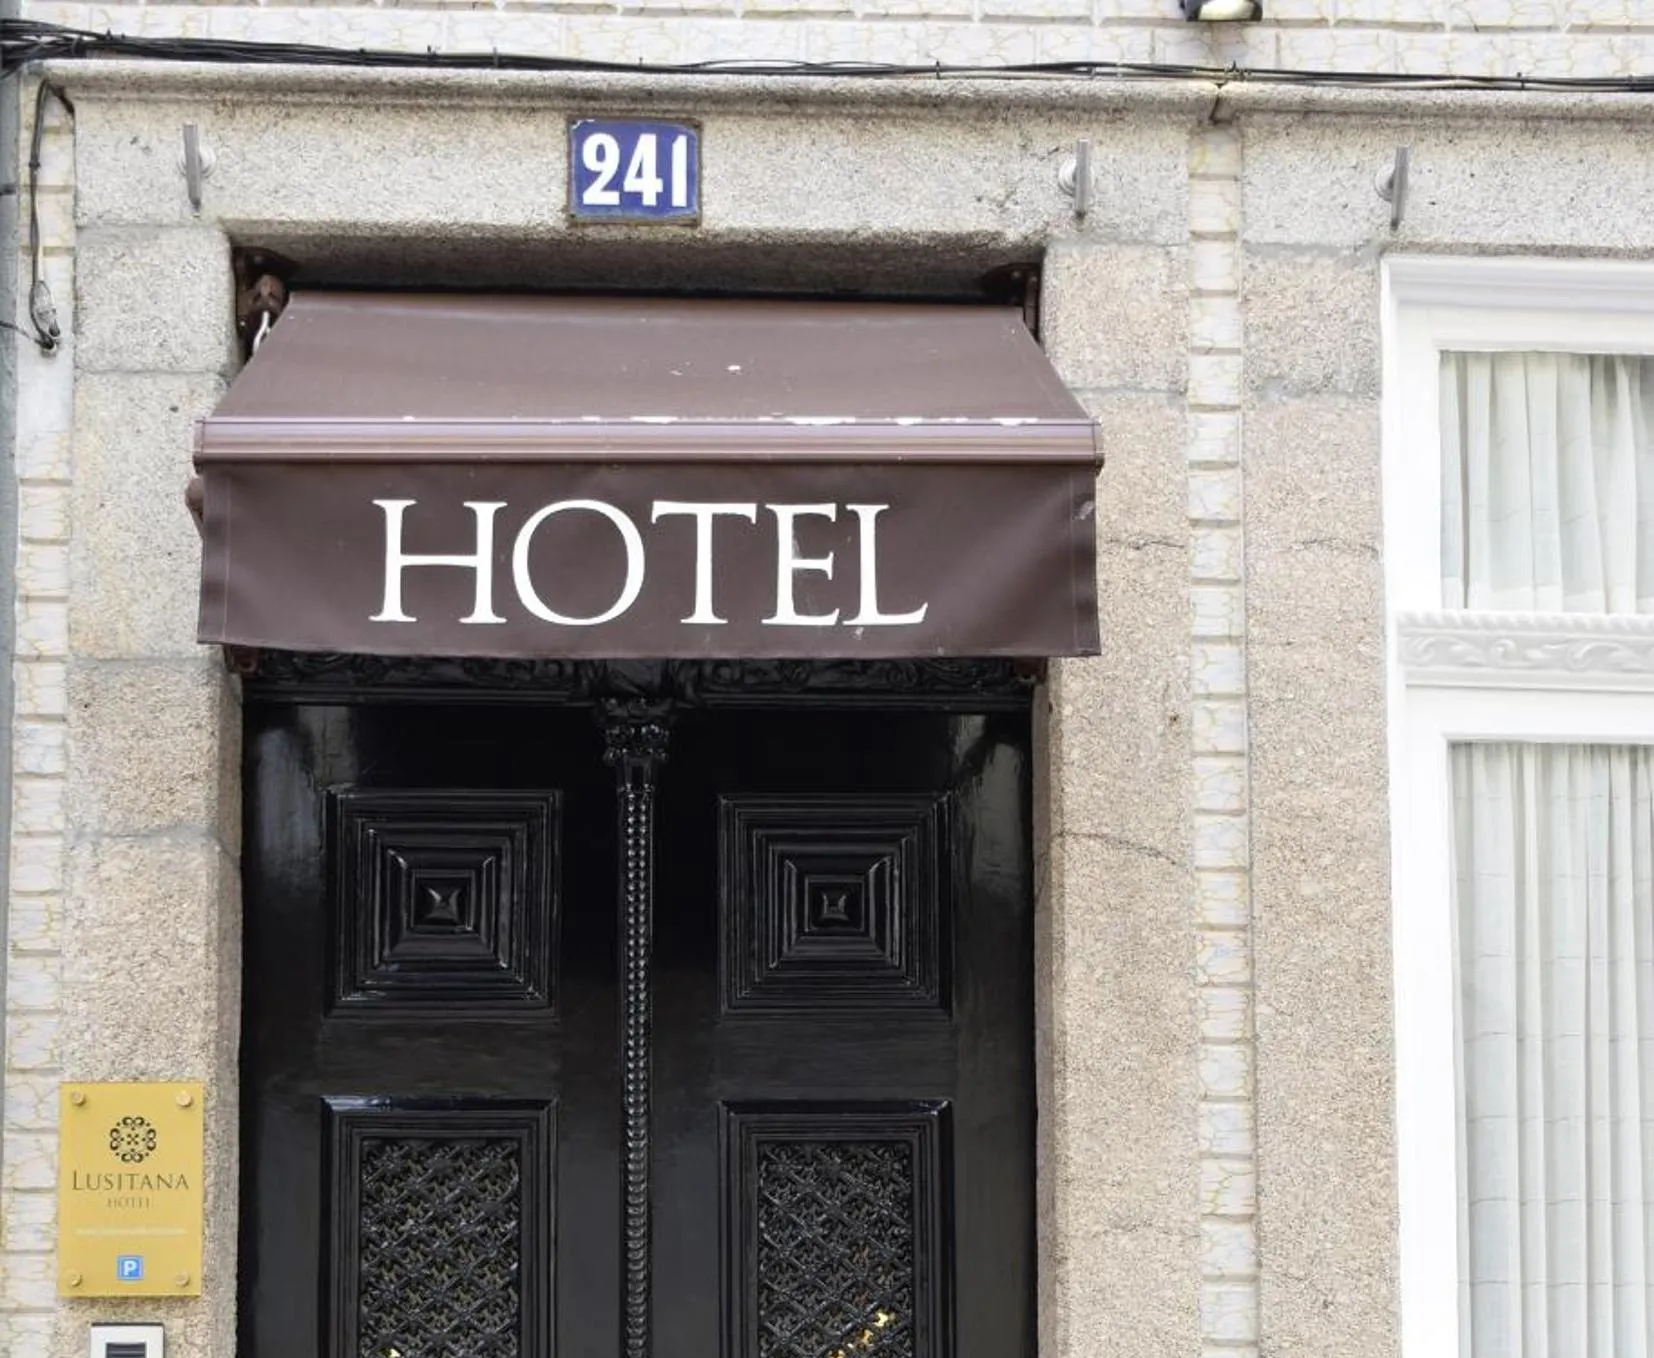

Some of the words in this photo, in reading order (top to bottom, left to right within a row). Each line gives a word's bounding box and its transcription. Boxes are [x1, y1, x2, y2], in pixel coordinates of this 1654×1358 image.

[582, 132, 688, 208] 241
[368, 499, 928, 626] HOTEL
[72, 1170, 190, 1191] LUSITANA
[124, 1260, 137, 1276] P
